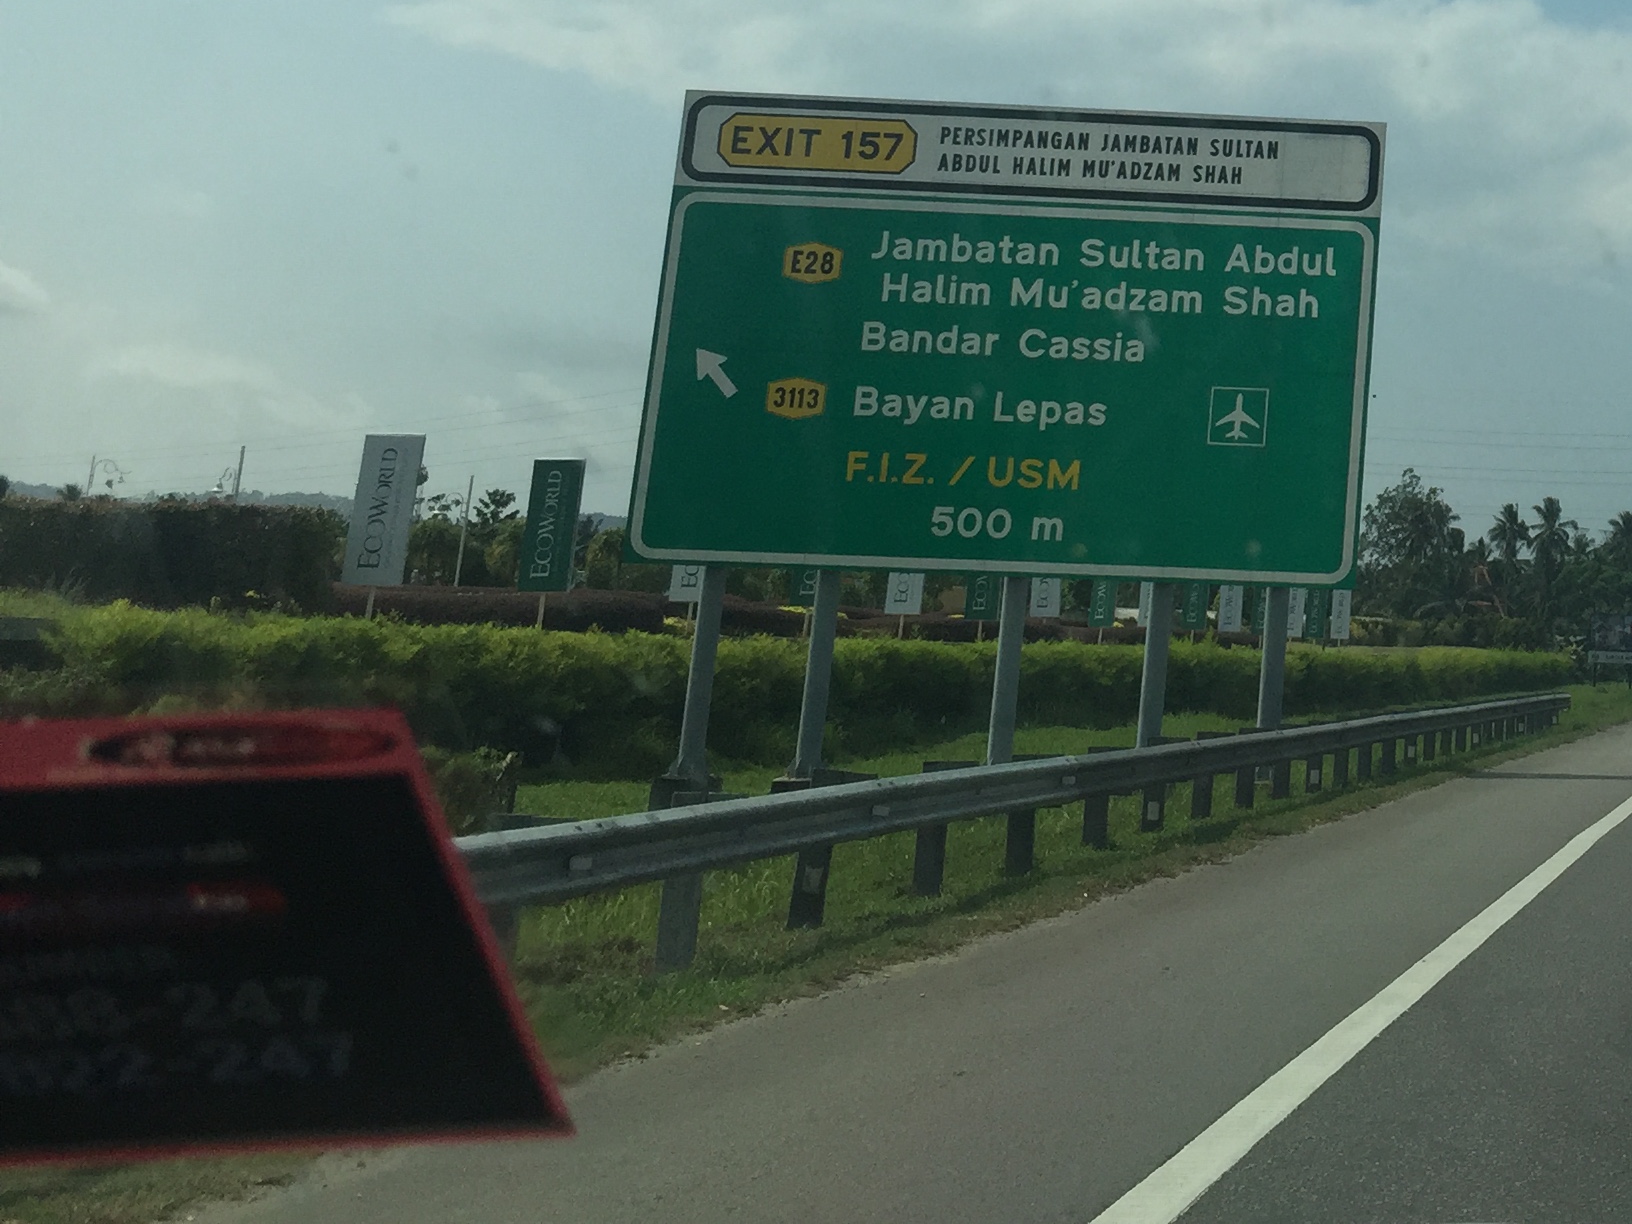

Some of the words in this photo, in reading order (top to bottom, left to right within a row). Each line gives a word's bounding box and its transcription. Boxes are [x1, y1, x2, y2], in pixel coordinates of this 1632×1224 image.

[731, 126, 821, 157] EXIT
[841, 130, 904, 161] 157
[939, 126, 1090, 151] PERSIMPANGAN
[1100, 133, 1199, 156] JAMBATAN
[1210, 139, 1279, 160] SULTAN
[937, 153, 1000, 175] ABDUL
[1012, 156, 1071, 178] HALIM
[1082, 159, 1181, 182] MU'ADZAM
[1193, 164, 1243, 185] SHAH
[790, 250, 835, 275] E28
[871, 230, 1060, 266] Jambatan
[1080, 238, 1205, 272] Sultan
[1224, 243, 1337, 277] Abdul
[881, 272, 991, 306] Halim
[1010, 276, 1203, 314] Mu'adzam
[1223, 286, 1319, 318] Shah
[861, 321, 1000, 356] Bandar
[1019, 328, 1145, 363] Cassia
[773, 386, 820, 409] 3113
[853, 385, 975, 425] Bayan
[994, 391, 1108, 431] Lepas
[846, 450, 935, 485] F.I.Z.
[987, 456, 1081, 490] USM
[930, 506, 1012, 539] 500
[1031, 515, 1064, 542] m
